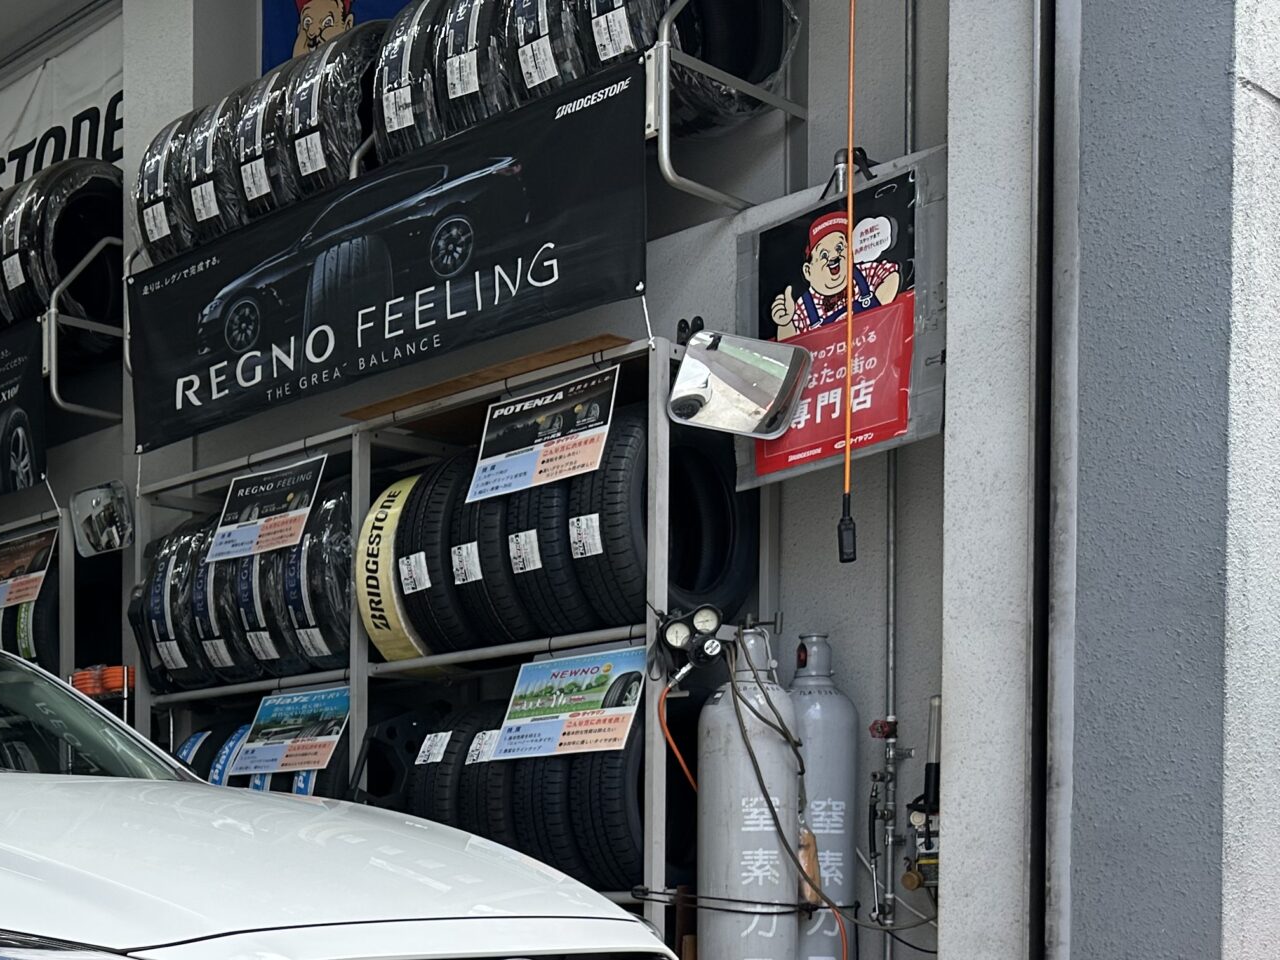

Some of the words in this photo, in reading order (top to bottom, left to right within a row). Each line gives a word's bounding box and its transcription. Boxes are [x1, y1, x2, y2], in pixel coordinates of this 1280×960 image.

[555, 77, 632, 120] BRIDGESTONE
[175, 324, 336, 411] REGNO
[356, 242, 560, 348] FEELING
[267, 385, 292, 401] THE
[299, 361, 348, 390] GREA
[358, 334, 442, 370] BALANCE
[493, 391, 564, 419] POTENZA
[237, 482, 274, 498] REGNO
[240, 557, 251, 605] REGN
[364, 487, 403, 632] BRIDGESTONE
[153, 560, 166, 619] REGNO
[550, 665, 600, 680] NEWNO
